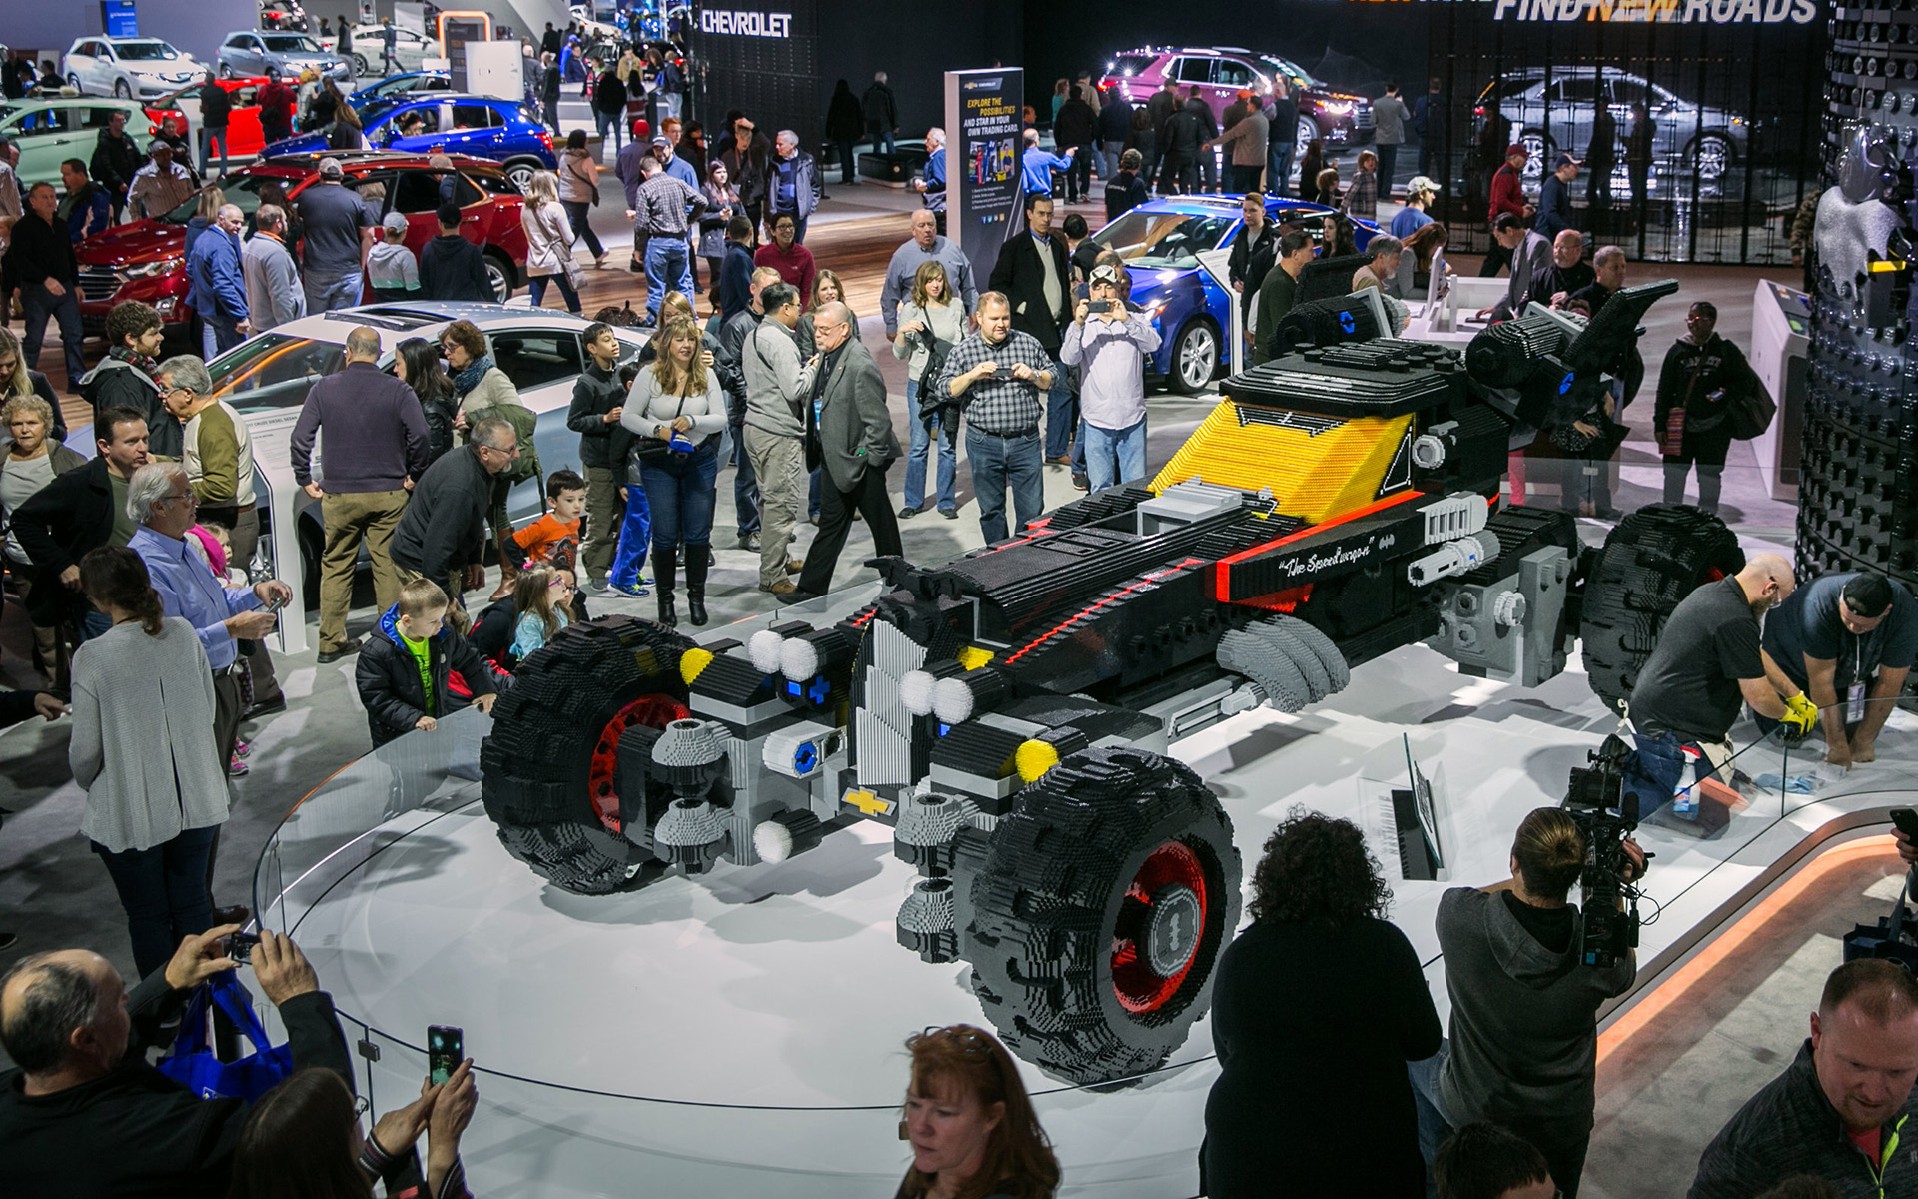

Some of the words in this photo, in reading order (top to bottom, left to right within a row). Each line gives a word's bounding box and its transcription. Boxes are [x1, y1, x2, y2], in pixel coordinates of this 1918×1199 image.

[701, 9, 792, 38] CHEVROLET
[967, 98, 991, 108] EXPLORE
[992, 97, 1002, 106] THE
[980, 105, 1015, 116] POSSIBILITIES
[963, 119, 975, 127] AND
[976, 117, 989, 126] STAR
[990, 117, 996, 125] IN
[996, 115, 1010, 124] YOUR
[968, 128, 981, 136] OWN
[982, 126, 1003, 135] TRADING
[1004, 124, 1018, 133] CARD.
